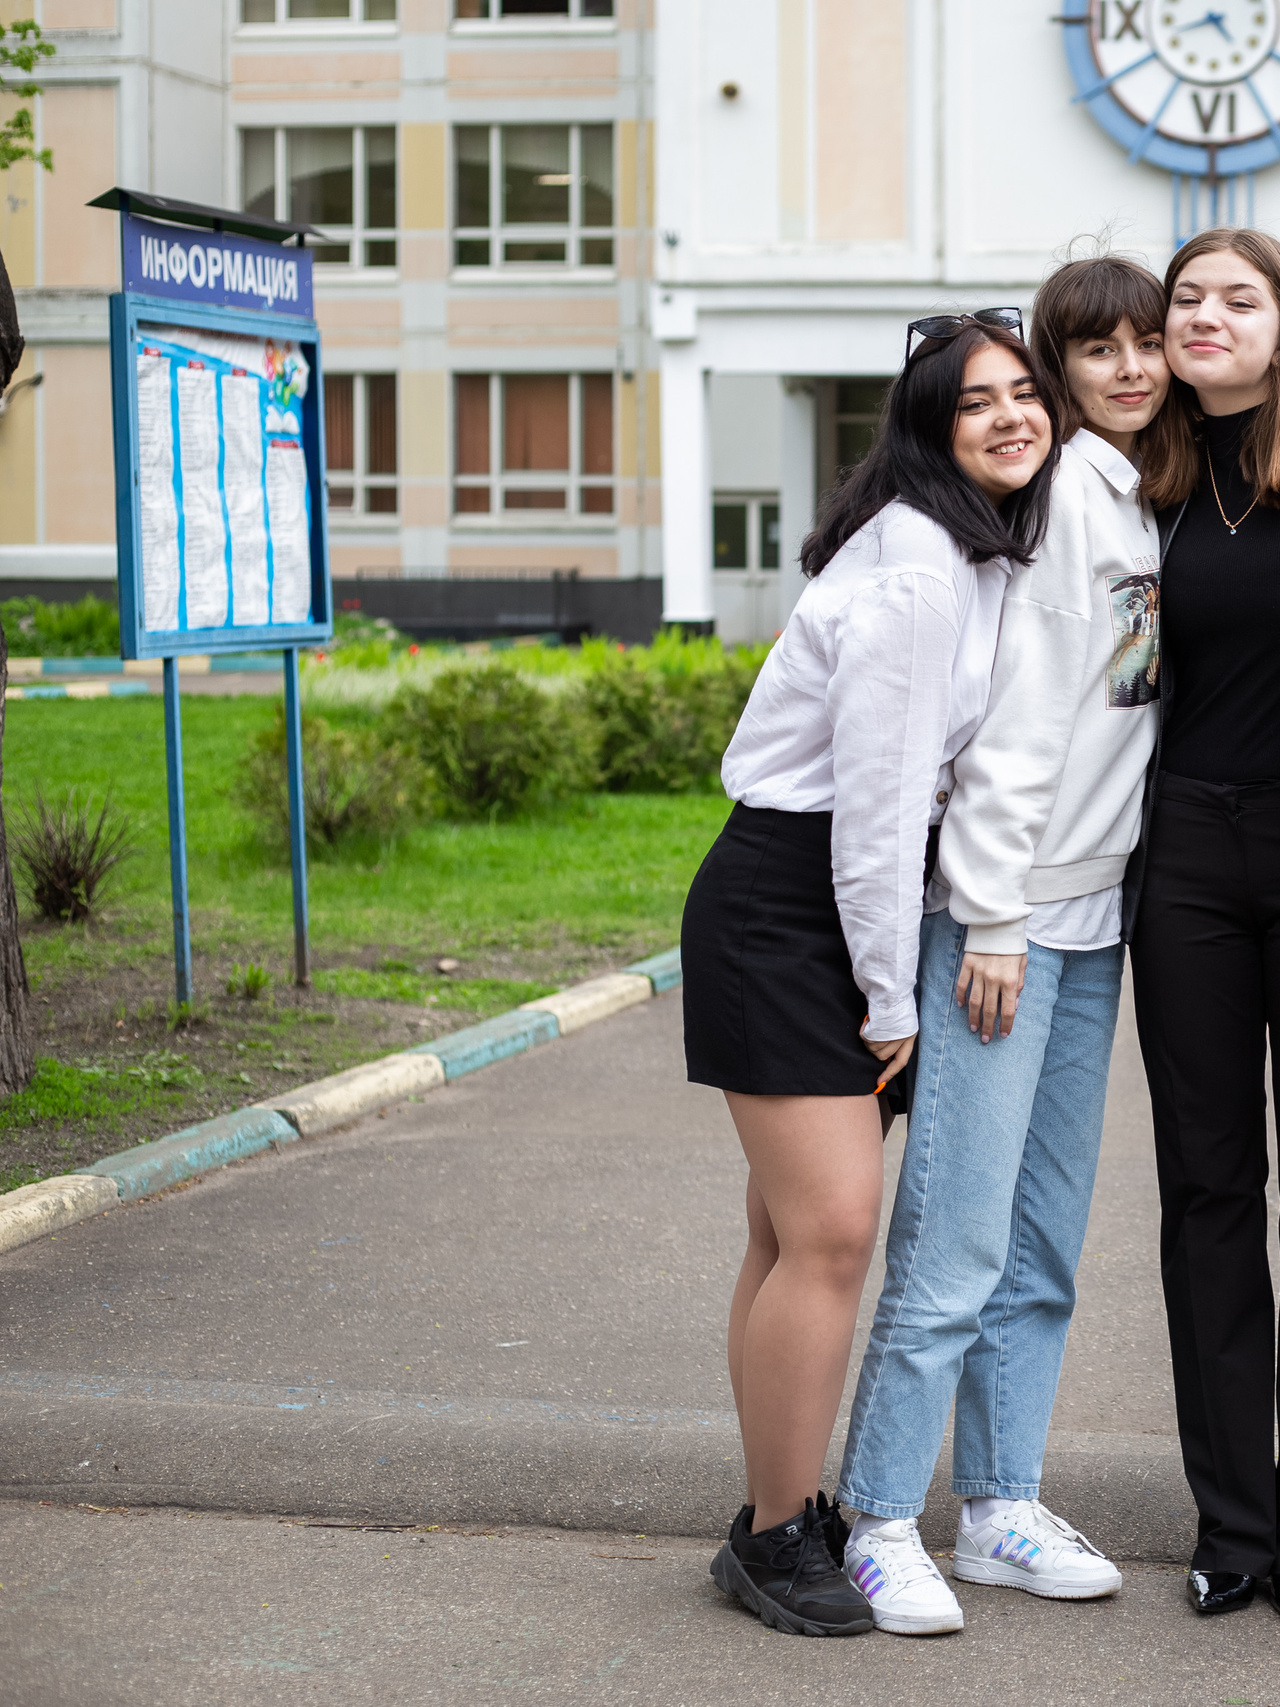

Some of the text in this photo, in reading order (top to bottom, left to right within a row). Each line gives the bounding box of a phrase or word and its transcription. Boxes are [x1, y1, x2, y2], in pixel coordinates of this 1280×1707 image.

[1100, 0, 1142, 40] IX
[1192, 91, 1235, 133] VI
[141, 235, 298, 305] ИНФОРМАЦИЯ
